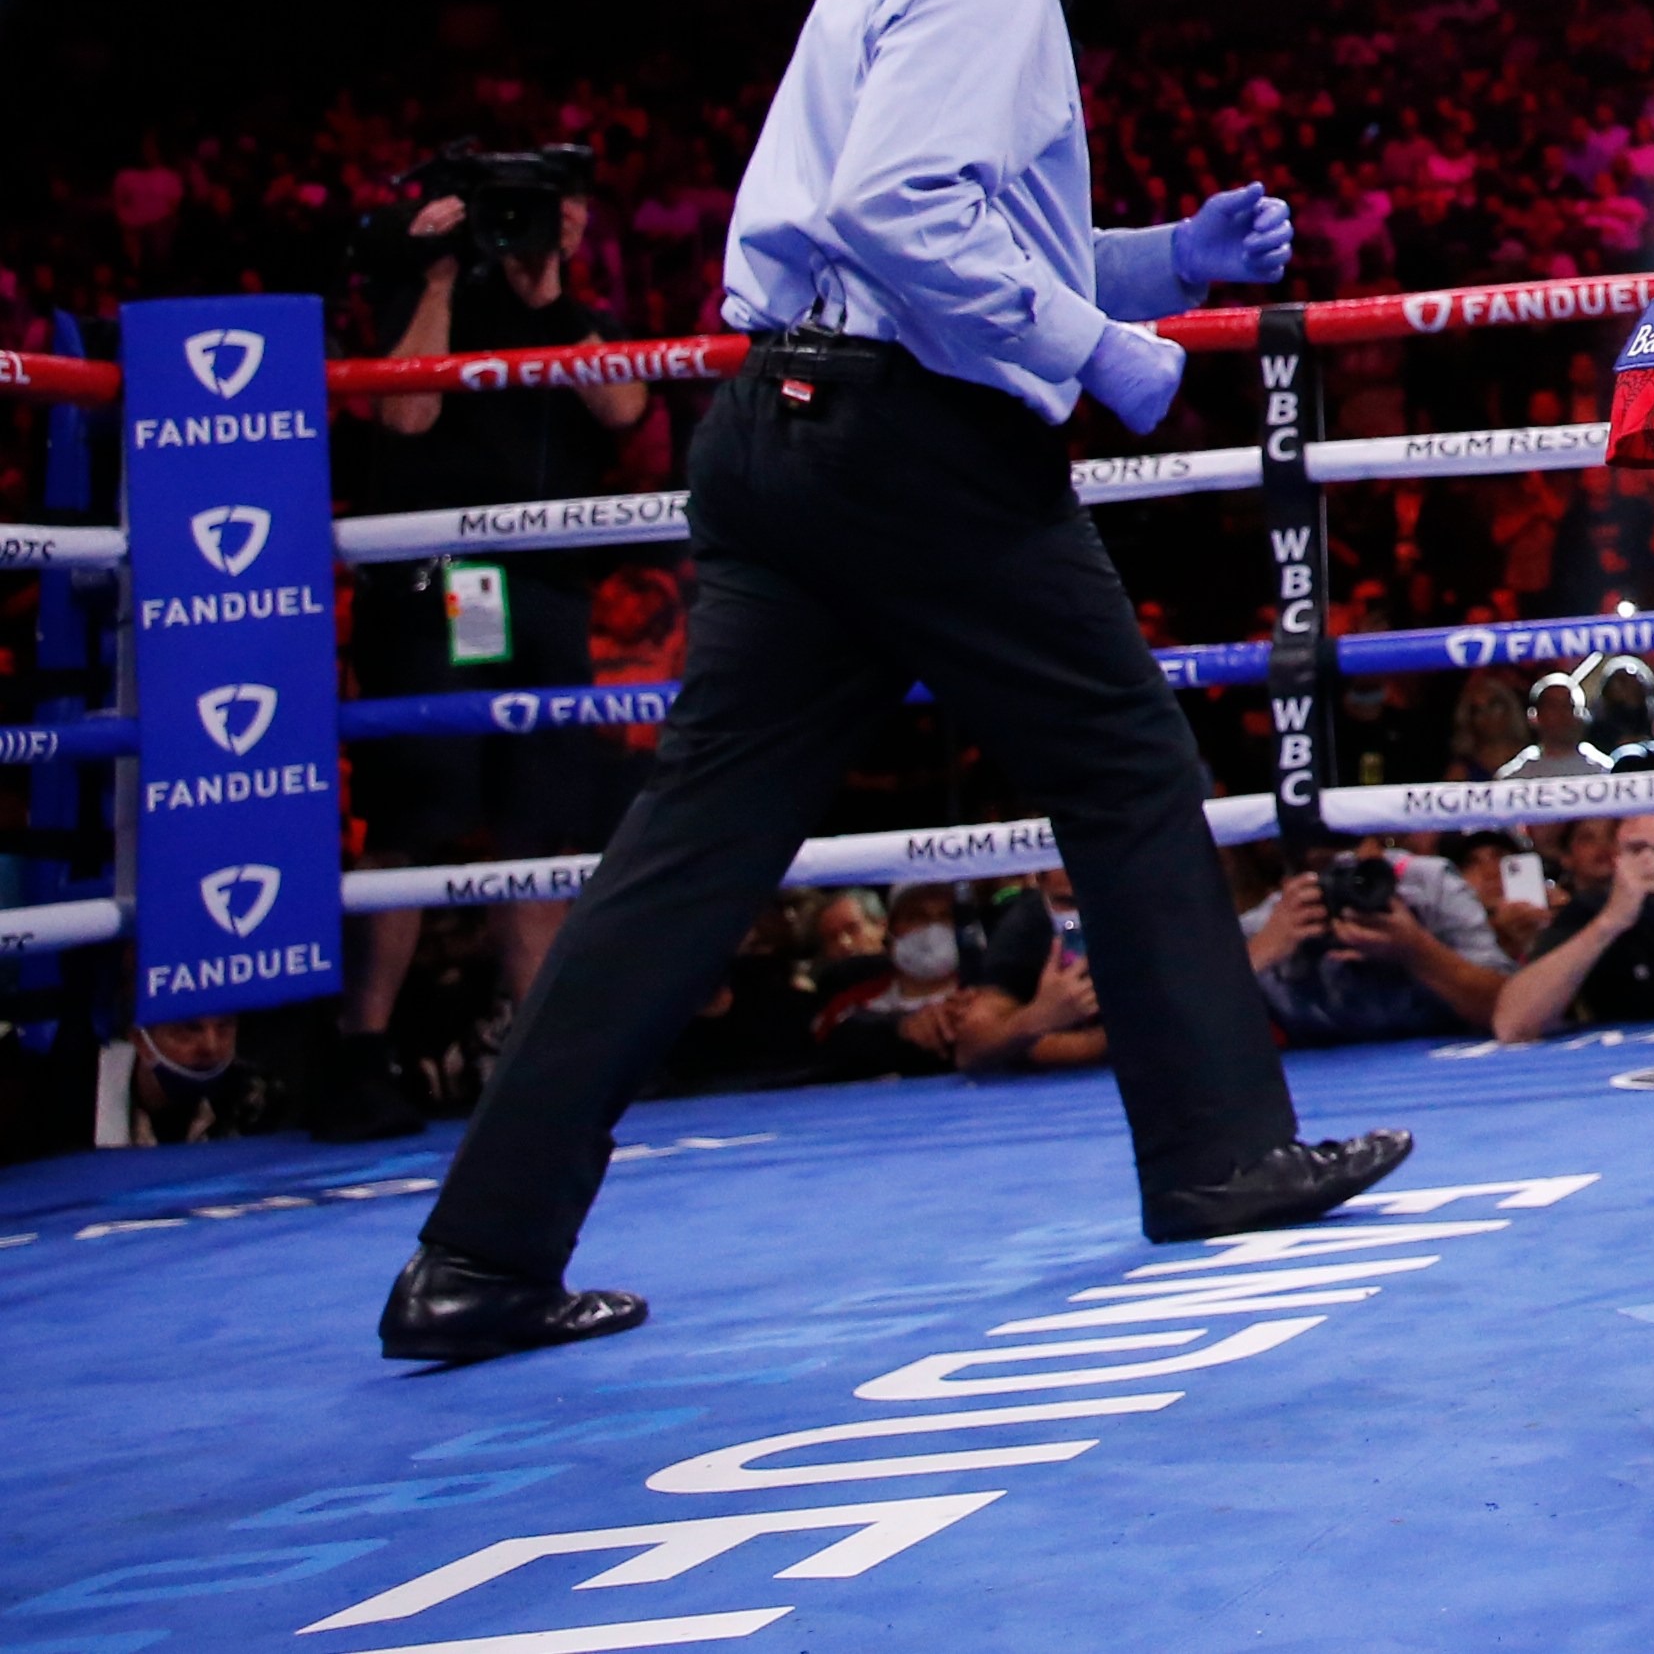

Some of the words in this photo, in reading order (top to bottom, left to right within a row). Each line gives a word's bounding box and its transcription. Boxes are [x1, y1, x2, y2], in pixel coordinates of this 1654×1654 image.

[1461, 279, 1651, 325] FANDUEL
[517, 344, 721, 388] FANDUEL
[135, 410, 317, 449] FANDUEL
[1261, 354, 1301, 462] WBC
[1406, 436, 1494, 460] MGM
[459, 507, 549, 537] MGM
[1270, 525, 1314, 634] WBC
[142, 586, 324, 629] FANDUEL
[1270, 695, 1314, 807] WBC
[146, 764, 329, 813] FANDUEL
[1404, 786, 1495, 816] MGM
[907, 832, 995, 861] MGM
[446, 871, 538, 902] MGM
[147, 943, 332, 999] FANDUEL
